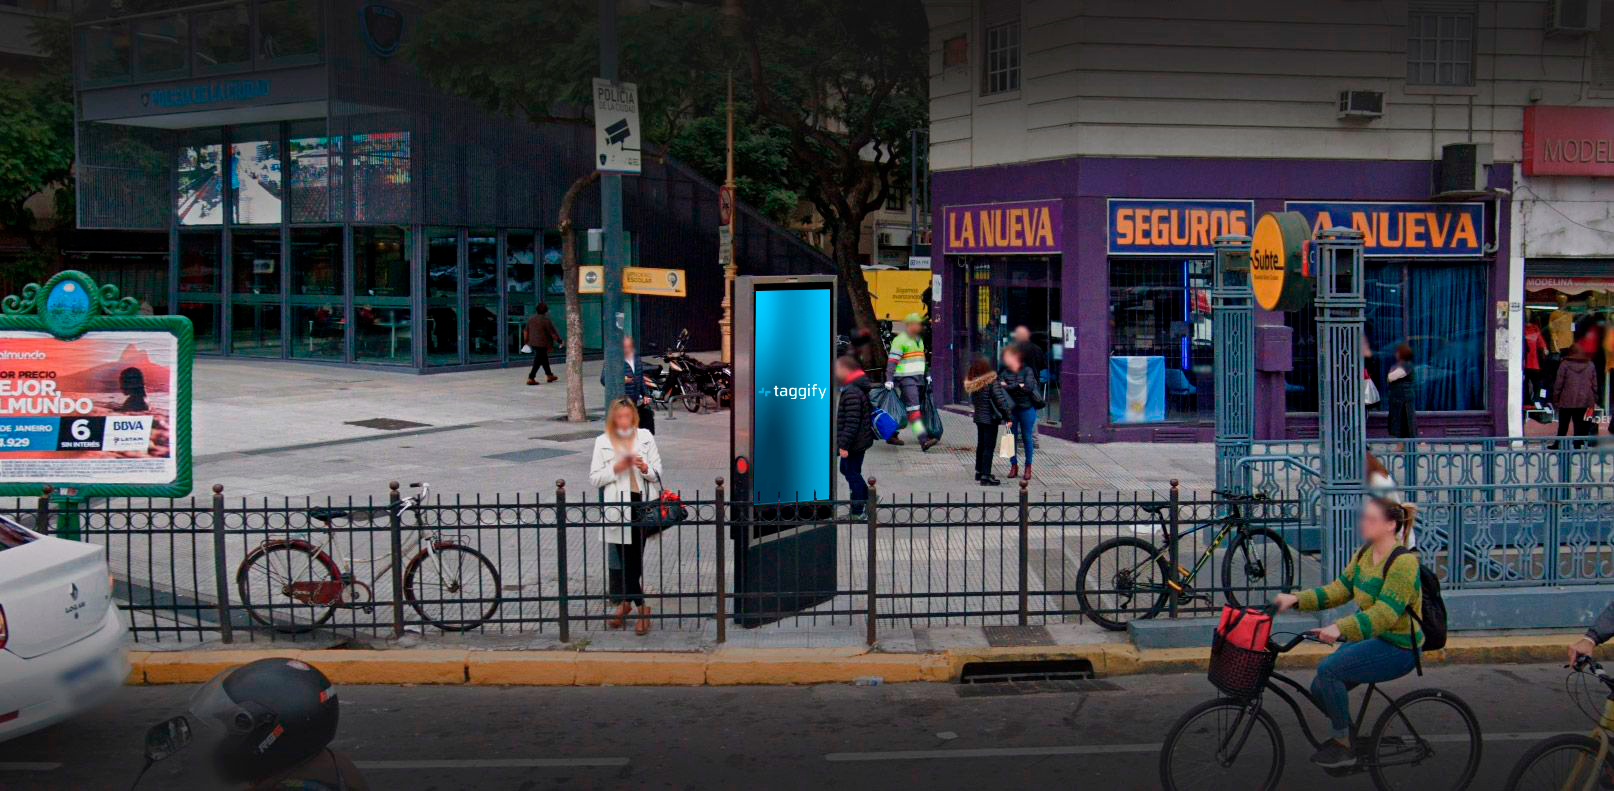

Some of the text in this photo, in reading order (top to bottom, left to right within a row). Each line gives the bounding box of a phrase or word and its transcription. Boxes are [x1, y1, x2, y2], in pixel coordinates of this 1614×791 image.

[949, 206, 1054, 248] LA NUEVA
[1116, 208, 1247, 246] SEGUROS
[1352, 211, 1478, 249] NUEVA
[1251, 249, 1283, 270] Subte
[1526, 278, 1574, 287] MODELINA
[18, 370, 57, 379] PRECIO
[0, 379, 61, 398] EJOR,
[773, 383, 827, 400] taggify
[15, 424, 53, 432] JANEIRO
[71, 418, 91, 441] 6
[113, 421, 144, 431] BBVA
